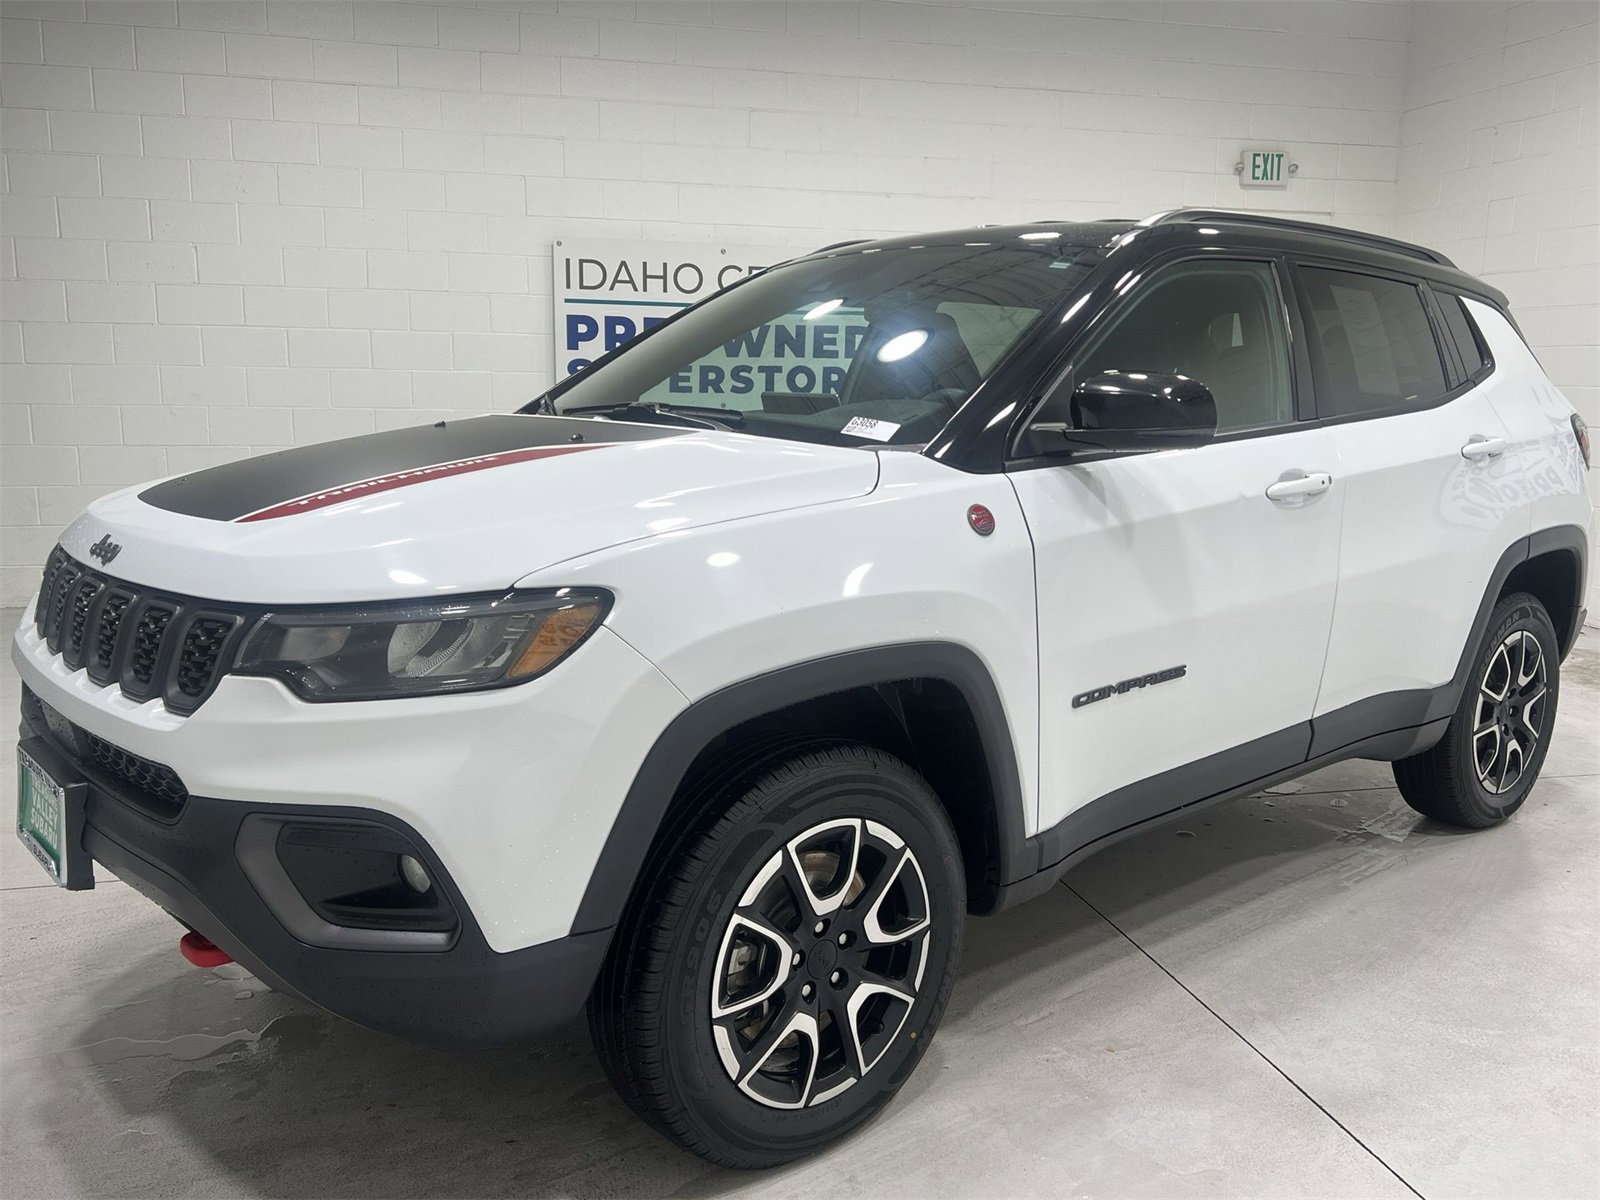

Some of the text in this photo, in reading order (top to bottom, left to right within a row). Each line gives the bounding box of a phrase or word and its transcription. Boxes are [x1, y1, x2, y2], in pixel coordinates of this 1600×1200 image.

[1252, 153, 1284, 181] EXIT
[565, 258, 703, 294] IDAHO
[1071, 664, 1187, 709] COMPASS
[30, 806, 58, 850] SUBARU
[31, 786, 58, 831] VALLEY
